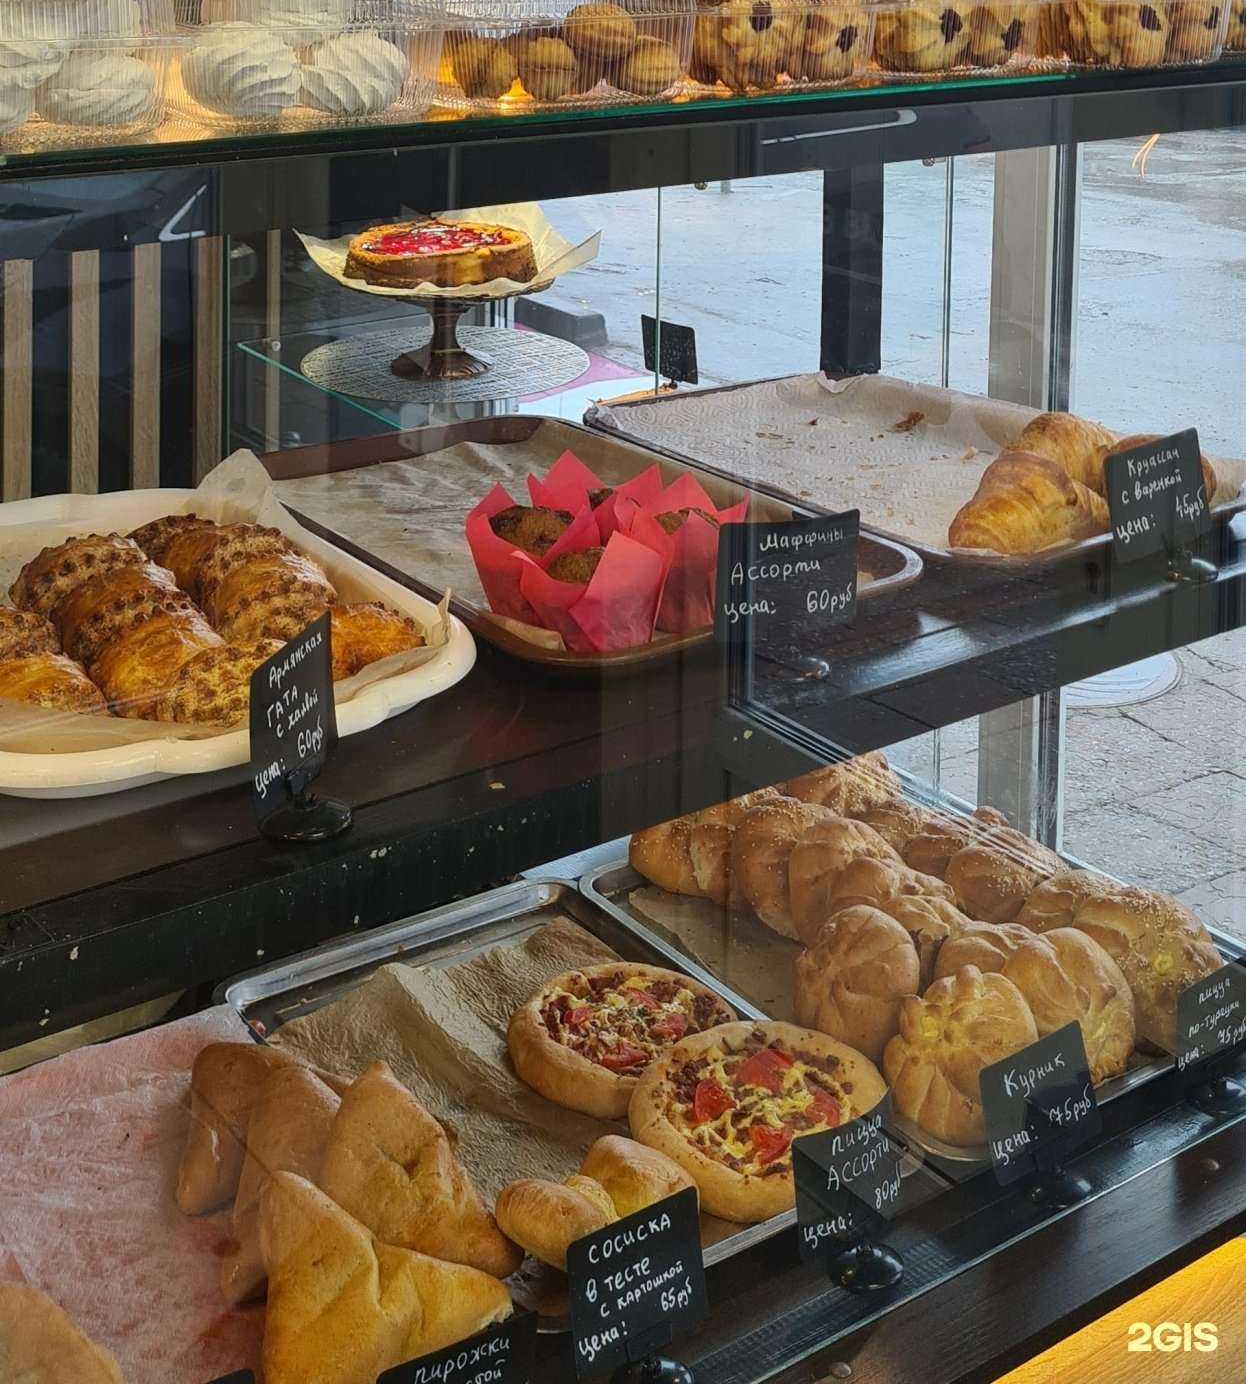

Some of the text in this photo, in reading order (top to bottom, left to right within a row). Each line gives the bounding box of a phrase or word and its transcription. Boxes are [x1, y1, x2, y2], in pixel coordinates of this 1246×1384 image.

[1127, 447, 1179, 477] Круассан
[731, 560, 821, 585] Ассорти
[269, 631, 323, 688] Армянская
[288, 688, 318, 731] халвой
[1003, 1052, 1065, 1098] Курник
[588, 1213, 672, 1264] СОСИСКА
